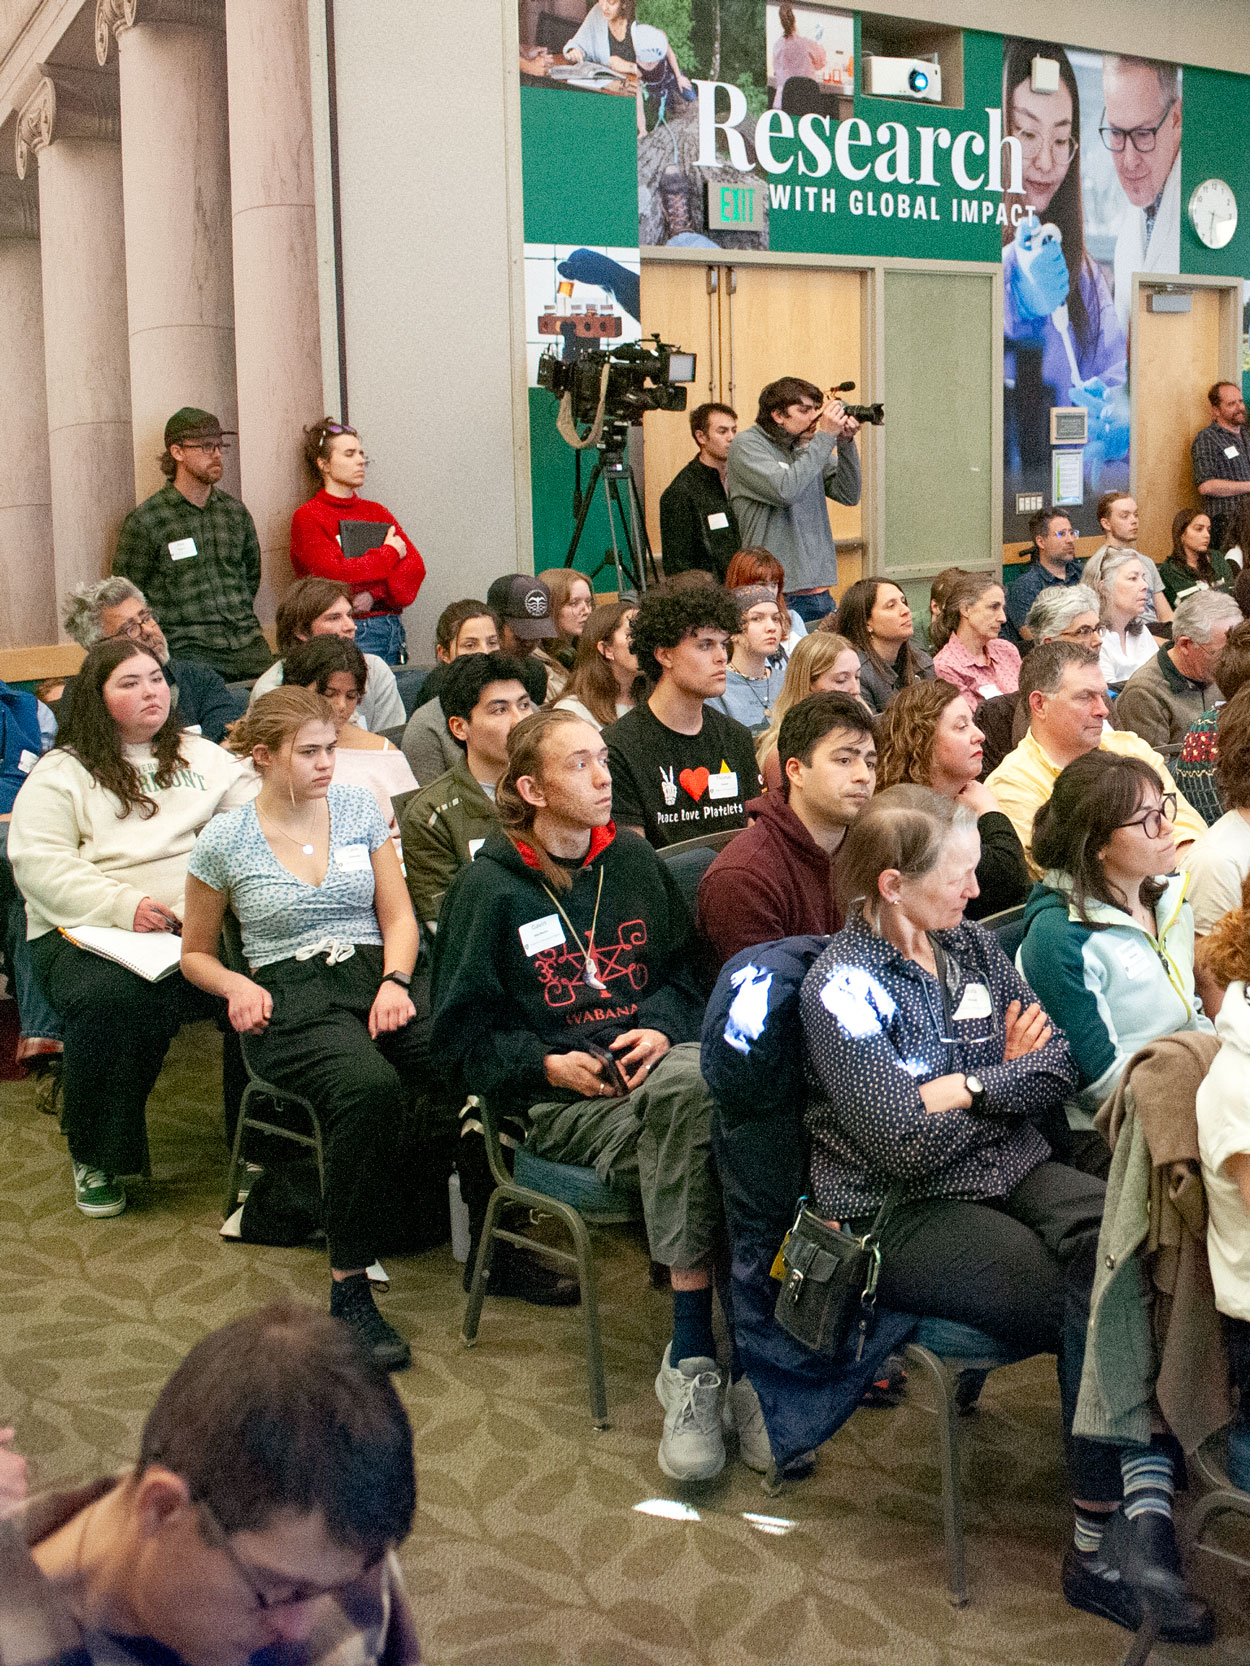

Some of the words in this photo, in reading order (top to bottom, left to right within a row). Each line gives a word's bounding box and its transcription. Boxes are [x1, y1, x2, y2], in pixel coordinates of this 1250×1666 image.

[691, 78, 1027, 195] Research
[720, 187, 755, 223] EXIT
[769, 184, 836, 213] WITH
[849, 190, 940, 221] GLOBAL
[952, 198, 1036, 228] IMPACT
[657, 811, 679, 824] Peace
[681, 808, 700, 821] Love
[703, 802, 743, 819] Platelets
